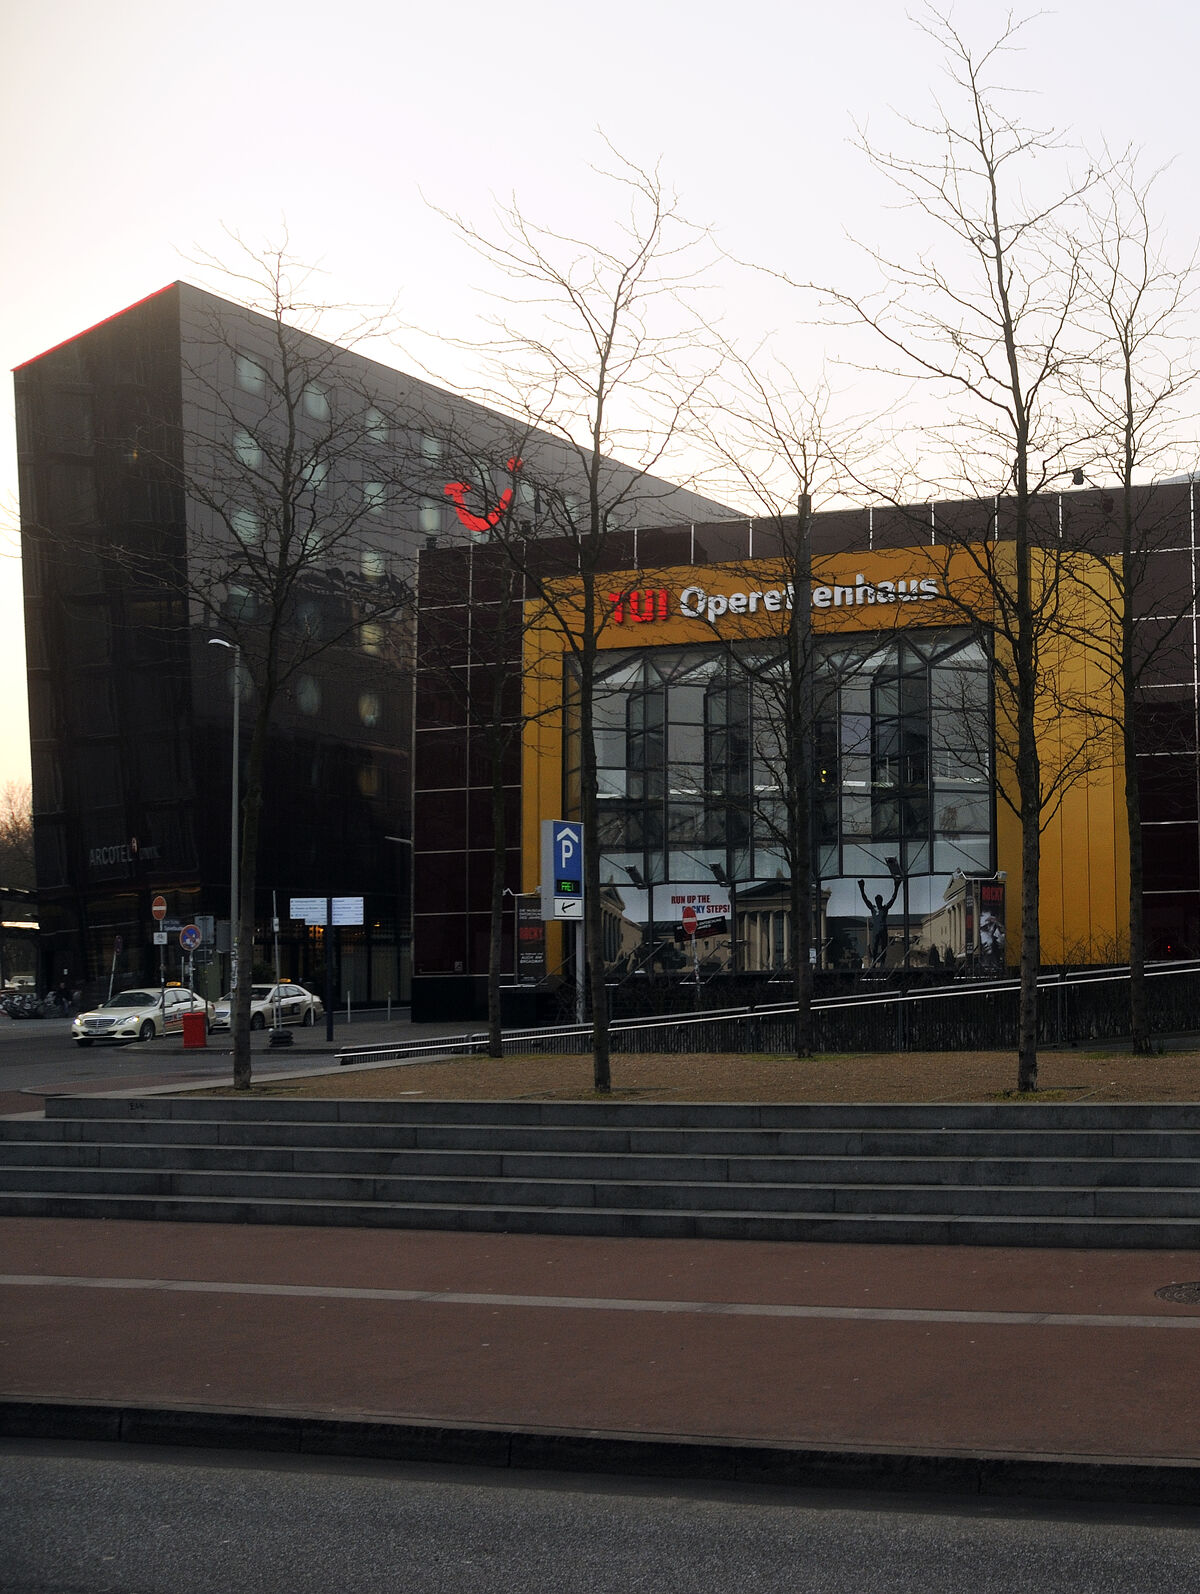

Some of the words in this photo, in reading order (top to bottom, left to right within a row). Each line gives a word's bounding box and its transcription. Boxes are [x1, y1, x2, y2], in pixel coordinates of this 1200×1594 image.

[608, 588, 669, 623] TUI
[680, 573, 939, 624] Operetenhaus
[561, 840, 574, 868] P
[671, 895, 686, 904] RUN
[687, 895, 696, 904] UP
[697, 894, 711, 904] THE
